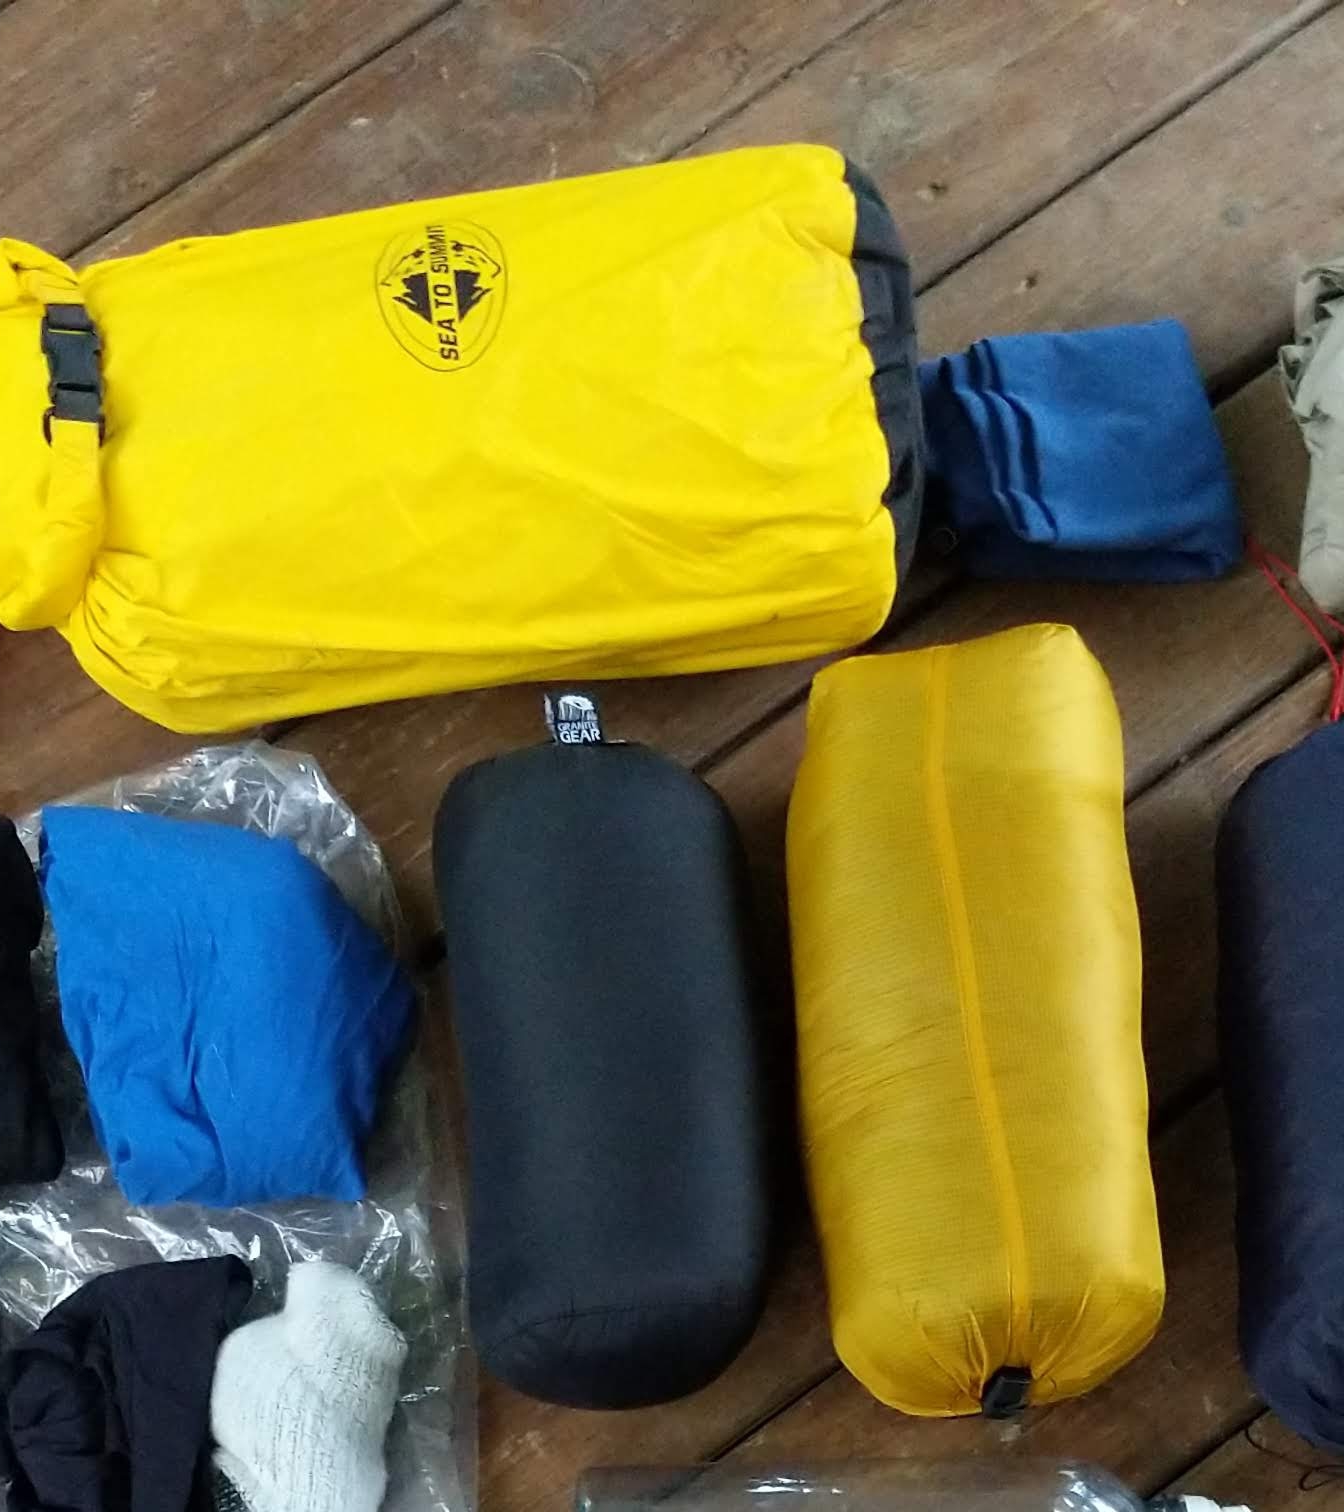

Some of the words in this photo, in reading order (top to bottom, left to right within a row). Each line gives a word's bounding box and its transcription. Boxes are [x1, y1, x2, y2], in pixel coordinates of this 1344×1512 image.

[426, 225, 449, 274] SUMMIT
[433, 284, 454, 309] TO
[437, 318, 460, 361] SEA
[559, 729, 601, 744] GEAR
